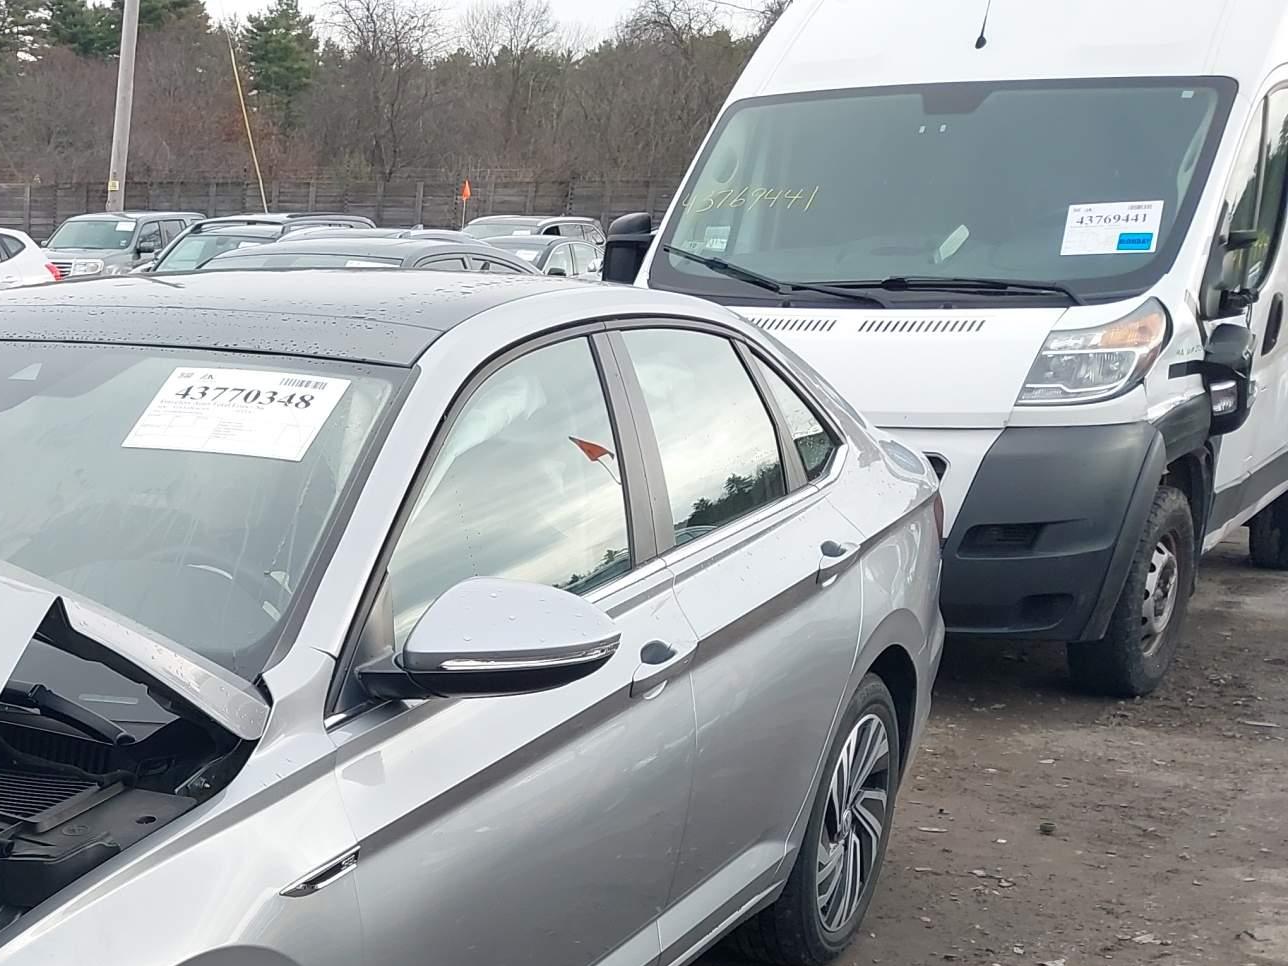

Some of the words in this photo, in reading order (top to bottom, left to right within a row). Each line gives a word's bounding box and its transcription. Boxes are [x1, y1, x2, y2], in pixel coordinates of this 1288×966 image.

[682, 184, 820, 214] 43769441
[1075, 213, 1147, 225] 43769441
[175, 384, 315, 410] 43770348
